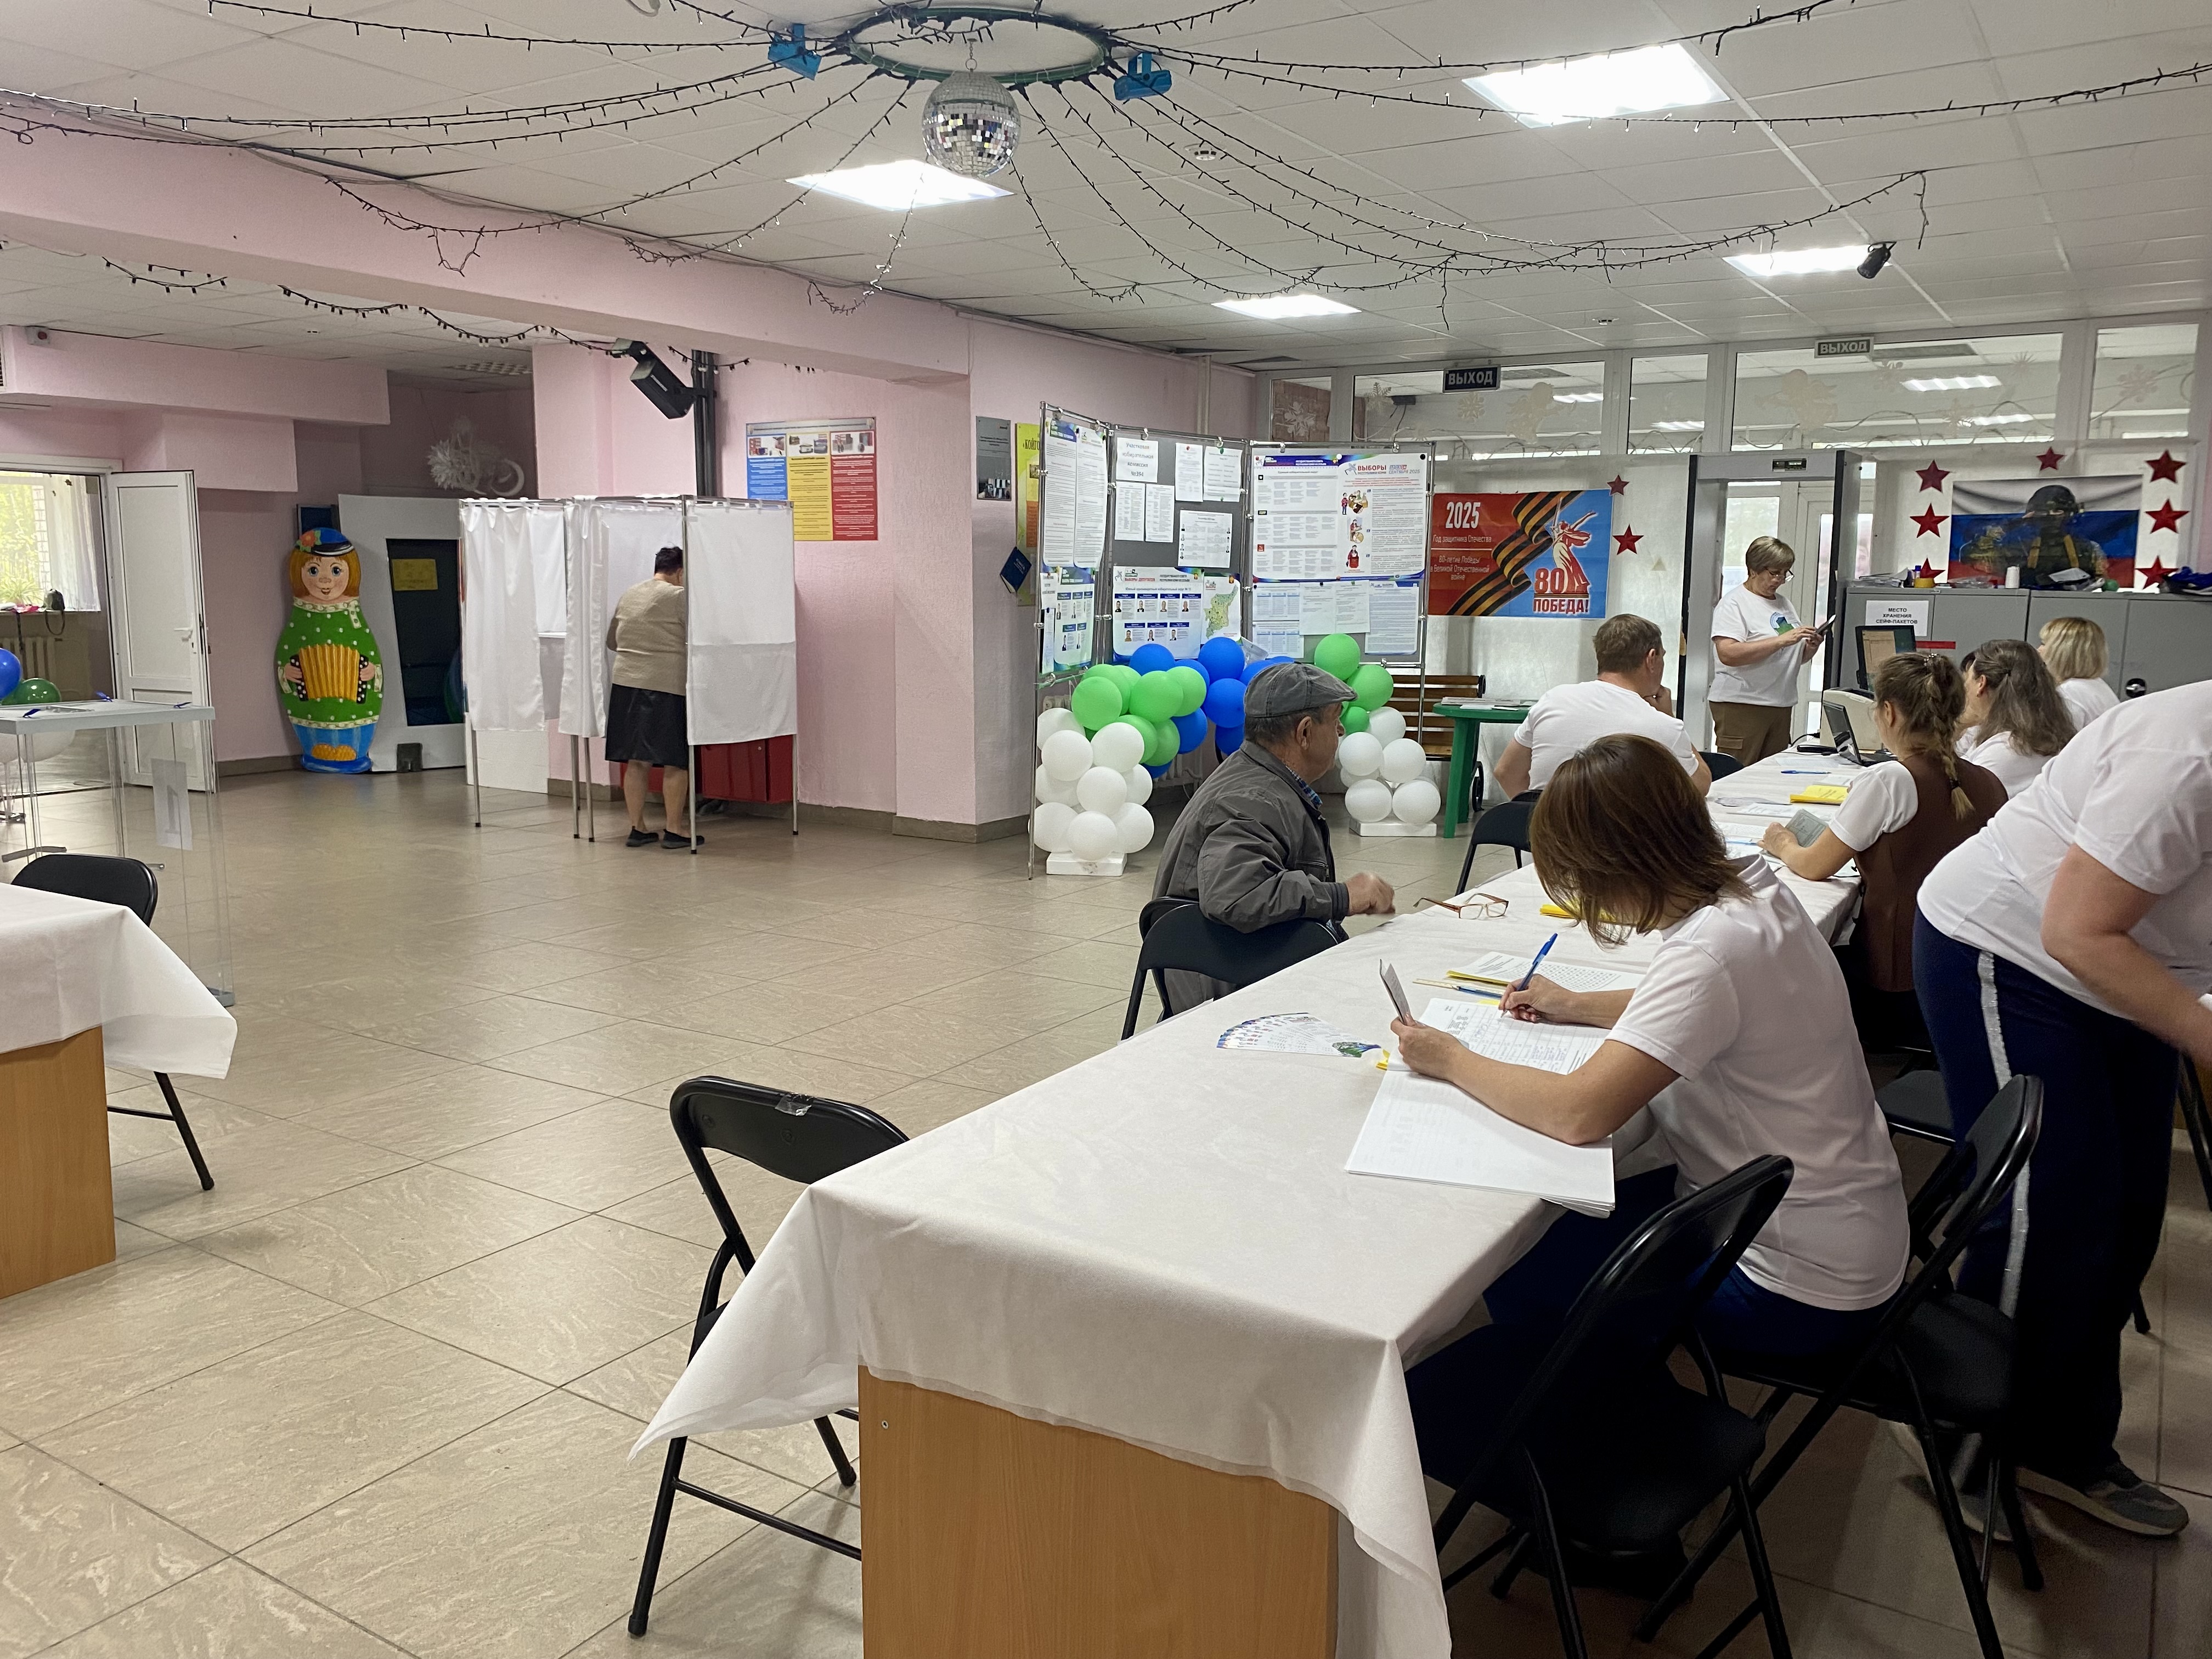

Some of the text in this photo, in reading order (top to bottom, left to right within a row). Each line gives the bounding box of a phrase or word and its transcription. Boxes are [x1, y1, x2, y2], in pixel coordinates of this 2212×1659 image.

[1820, 341, 1867, 354] ВЫХОД
[1448, 370, 1493, 386] ВЫХОД
[1446, 501, 1481, 529] 2025
[1433, 534, 1442, 543] Год
[1468, 534, 1492, 543] Отечества
[1439, 555, 1480, 564] 80-летие Победы
[1454, 565, 1489, 573] Отечественной
[1534, 567, 1565, 594] 80
[1533, 599, 1589, 614] ПОБЕДА!
